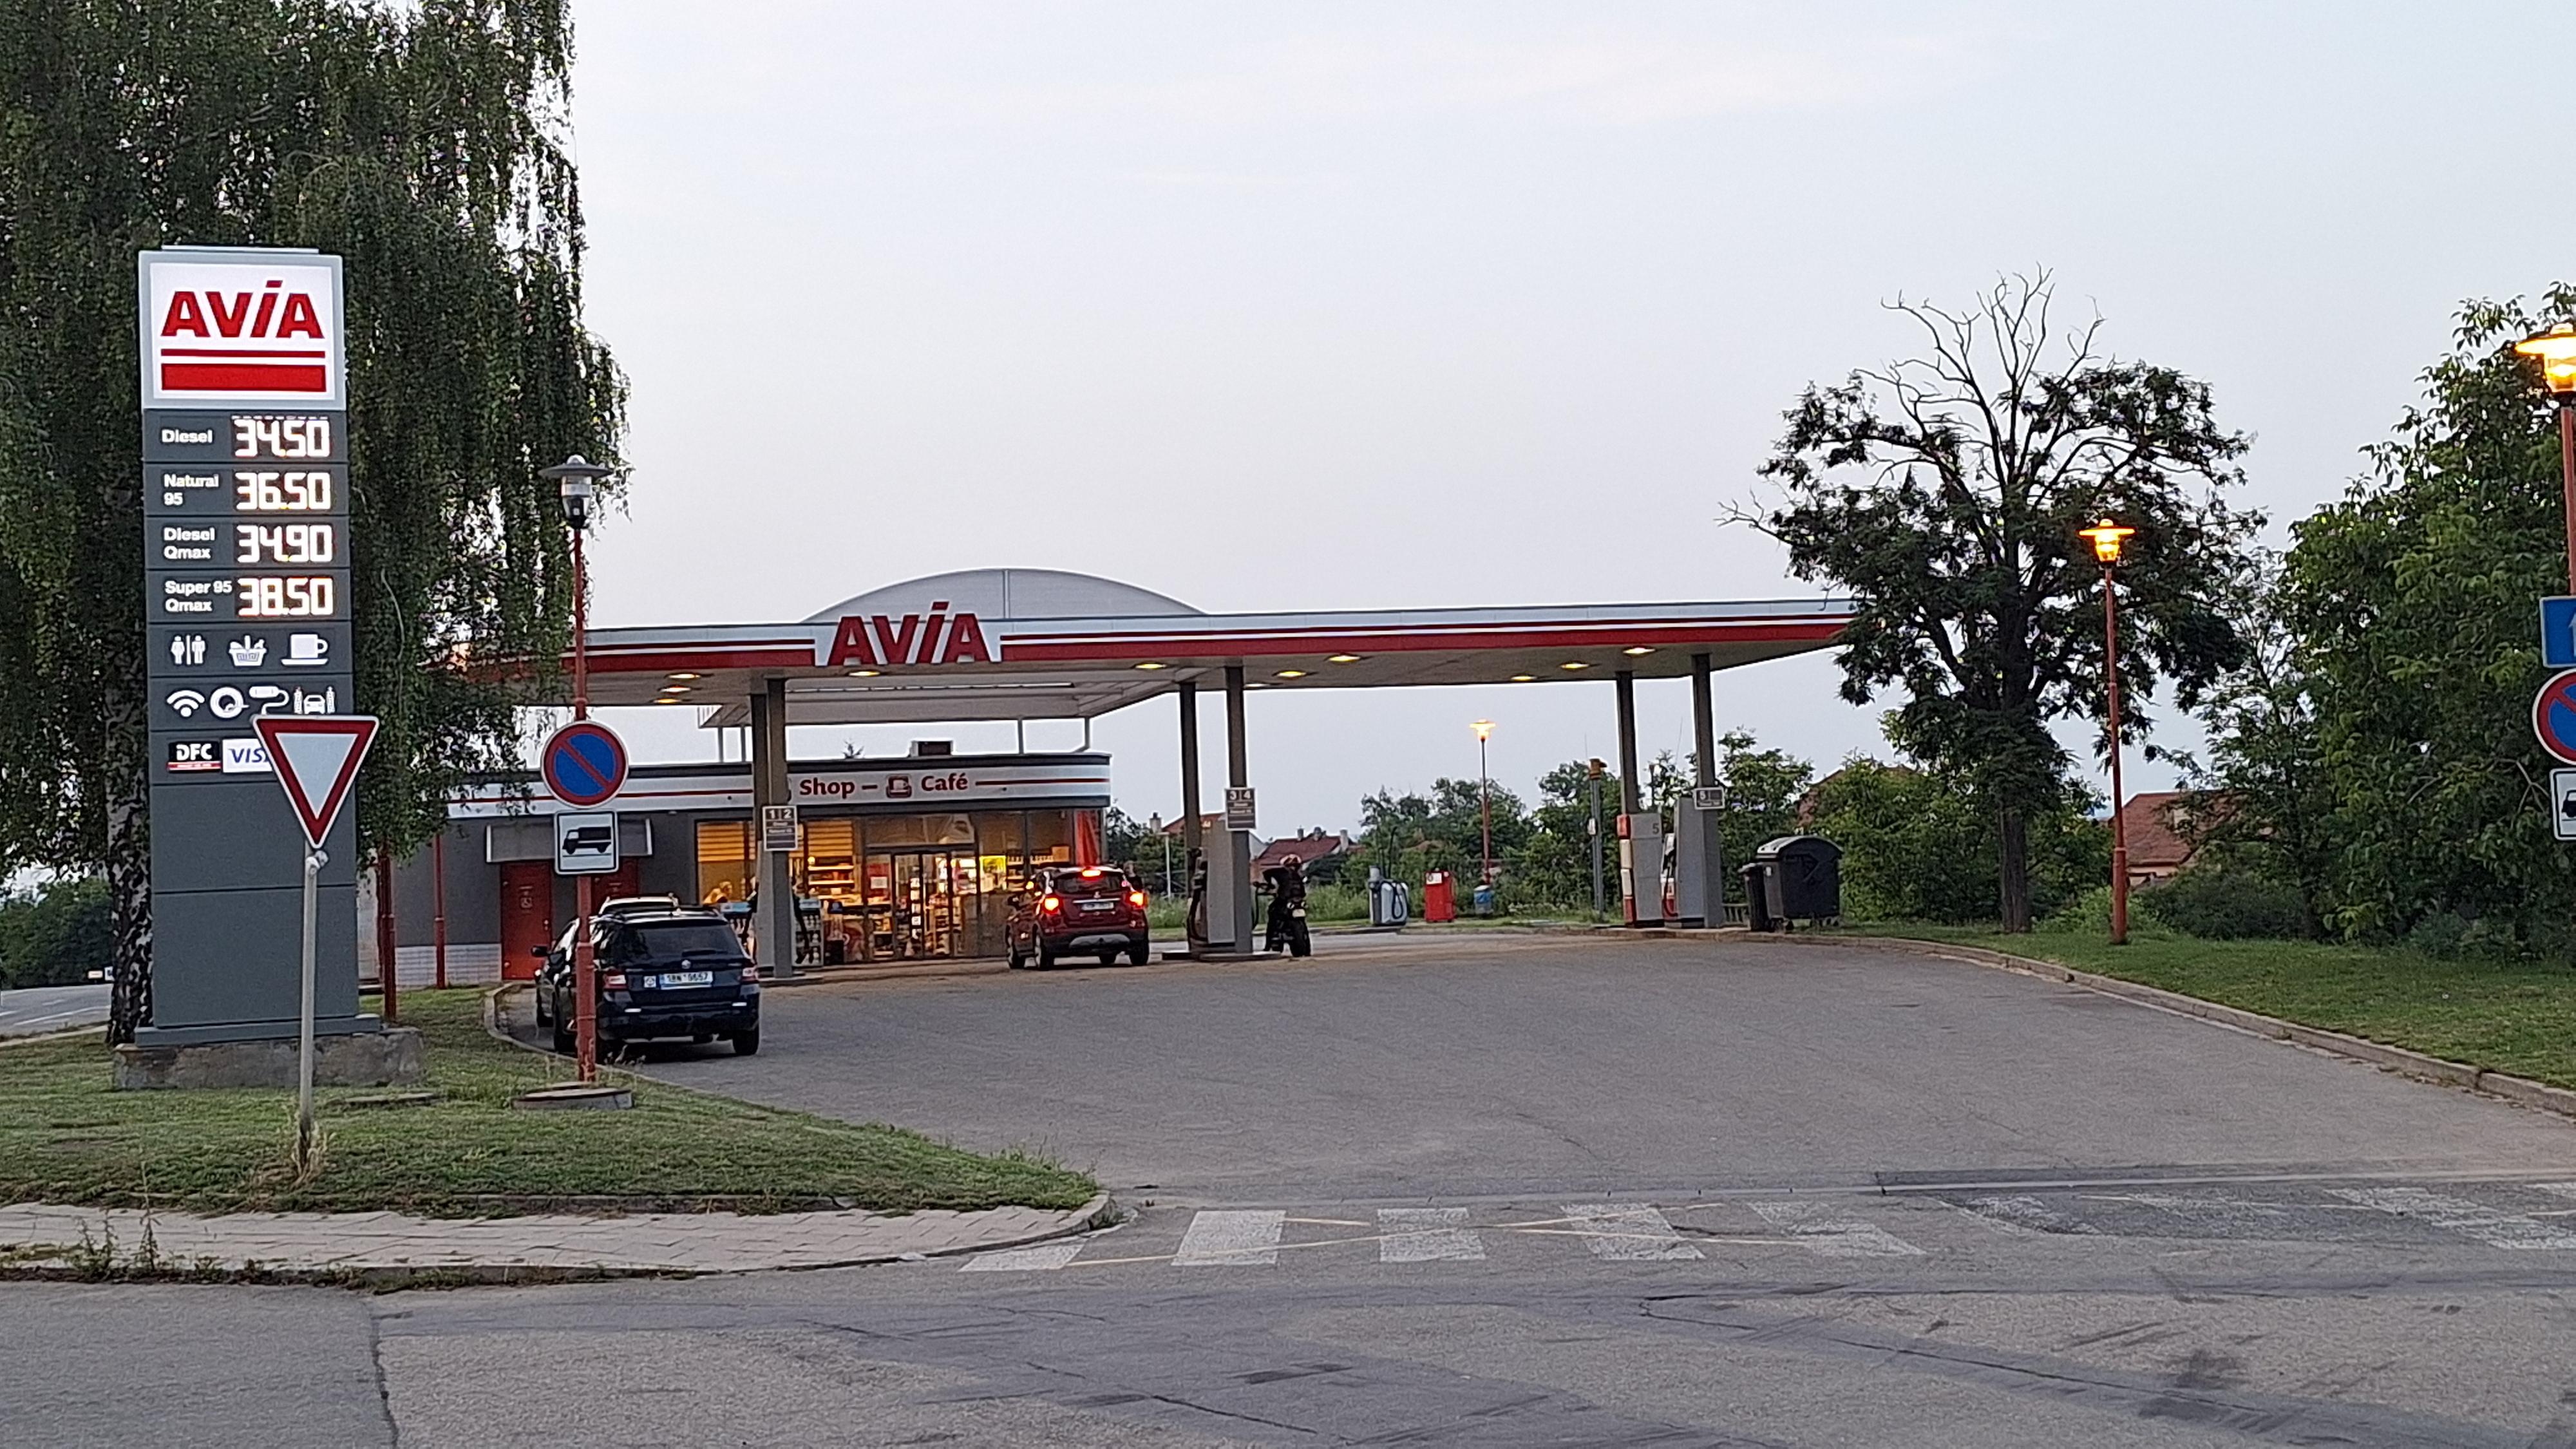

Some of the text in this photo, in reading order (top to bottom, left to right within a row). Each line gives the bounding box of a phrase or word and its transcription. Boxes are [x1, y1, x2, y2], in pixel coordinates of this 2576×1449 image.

[161, 419, 330, 457] Diesel 34.50
[164, 472, 332, 509] Natural 36.50
[164, 492, 184, 506] 95
[164, 525, 333, 563] Diesel 34.90
[164, 545, 211, 560] Qmax
[165, 578, 334, 616] Super 95 38.50
[165, 598, 213, 612] Qmax
[176, 743, 213, 761] DFC
[228, 748, 269, 763] VIS
[799, 773, 968, 799] Shop Café
[769, 809, 791, 819] 1 2
[1652, 823, 1660, 835] 5
